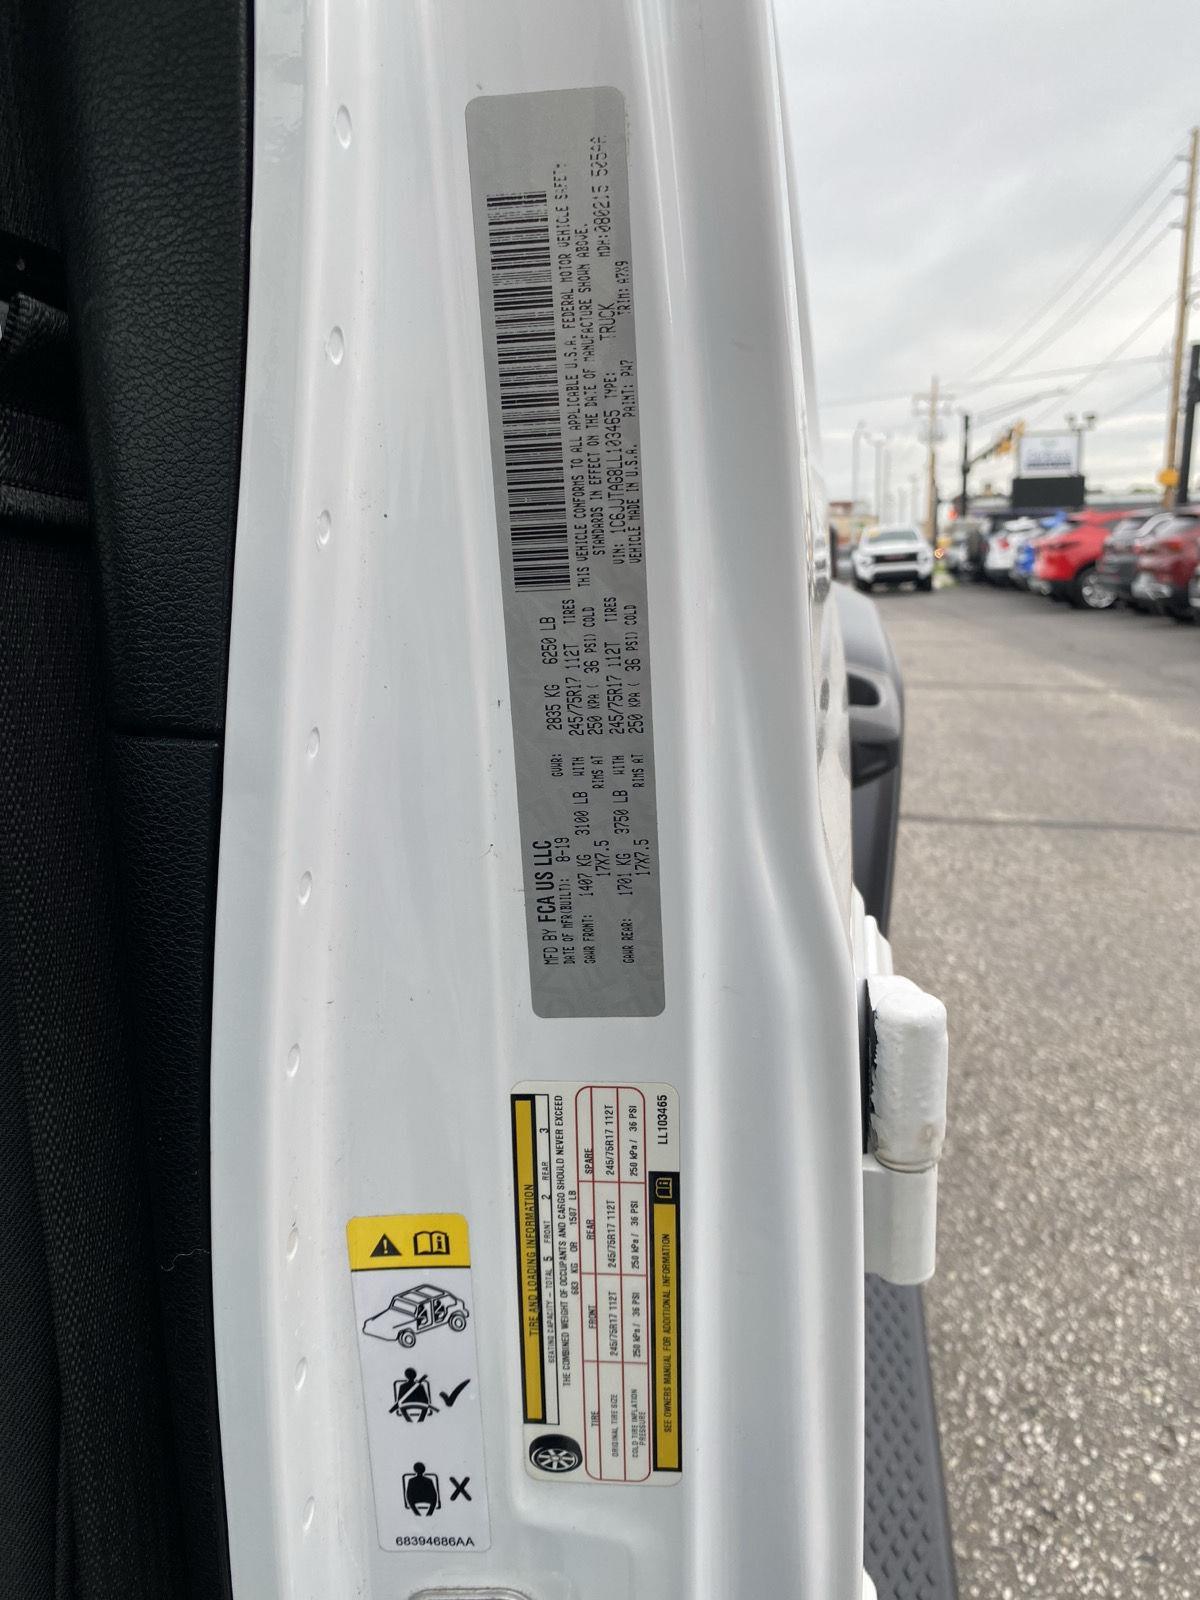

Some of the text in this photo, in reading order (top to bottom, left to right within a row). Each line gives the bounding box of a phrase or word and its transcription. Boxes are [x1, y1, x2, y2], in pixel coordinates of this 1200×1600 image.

[555, 205, 571, 247] VEHICLE
[557, 252, 573, 283] MOTOR
[559, 288, 576, 329] FEDERAL
[597, 302, 616, 341] TRUCK
[562, 335, 578, 368] U.S.A.
[564, 374, 581, 430] APPLICABLE
[574, 222, 605, 556] STANDARDS IN EFFECT ON THE DATE OF MANUFACTURE SHOWN ABOVE.
[602, 371, 617, 399] TYPE:
[620, 384, 635, 418] PAINT:
[568, 435, 582, 452] ALL
[623, 444, 638, 477] U.S.A.
[569, 458, 583, 468] TO
[602, 409, 626, 533] 1C6JJTAG8LL103465
[570, 474, 586, 518] CONFORMS
[625, 481, 639, 491] IN
[626, 498, 640, 520] MADE
[573, 523, 589, 561] VEHICLE
[611, 543, 625, 564] VIN:
[627, 525, 642, 563] VEHICLE
[576, 566, 590, 587] THIS
[538, 616, 563, 776] GVWR: 2835 KG 6250 LB
[581, 606, 610, 876] 17X7.5 RIMS AT 250 KPA 36 PSI) COLD
[623, 604, 650, 875] 17X7.5 RIMS AT 250 KPA 36 PSI) COLD
[561, 598, 596, 963] GAWR FRONT: 1407 KG 3100 LB WITH 245/75R17 112T TIRES
[603, 596, 634, 963] GAWR REAR: 1701 KG 3750 LB WITH 245/75R17 112T TIRES
[531, 840, 559, 964] MFD BY FCA US LLC
[553, 837, 575, 964] DATE OF MFR(BUILT): 8-19
[656, 1094, 668, 1144] LL103465
[604, 1104, 614, 1175] 245/75R17 112T
[628, 1104, 638, 1176] 250 kPa 36 PSI
[541, 1160, 549, 1180] REAR
[583, 1147, 592, 1174] SPARE
[568, 1190, 576, 1200] LB
[543, 1219, 551, 1243] FRONT
[554, 1095, 570, 1386] THE COMBINED WEIGHT OF OCCUPANTS AND CARGO SHOULD NEVER EXCEED
[569, 1241, 578, 1252] OR
[585, 1218, 595, 1239] REAR
[606, 1199, 616, 1268] 245/75R17 112T
[630, 1200, 639, 1269] 250 kPa 36 PSI
[523, 1184, 538, 1336] TIRE AND LOADING INFORMATION
[544, 1268, 552, 1289] TOTAL
[569, 1262, 578, 1274] KG
[545, 1300, 554, 1333] CAPACITY
[587, 1304, 597, 1328] FRONT
[608, 1290, 618, 1356] 245/75R17 112T
[631, 1291, 640, 1357] 250 kPa 36 PSI
[661, 1233, 672, 1432] SEE OWNERS MANUAL FOR ADDITIONAL INFORMATION
[546, 1334, 554, 1363] SEATING
[590, 1410, 599, 1426] TIRE
[638, 1410, 646, 1446] PRESSURE
[395, 1536, 475, 1548] 68394686AA
